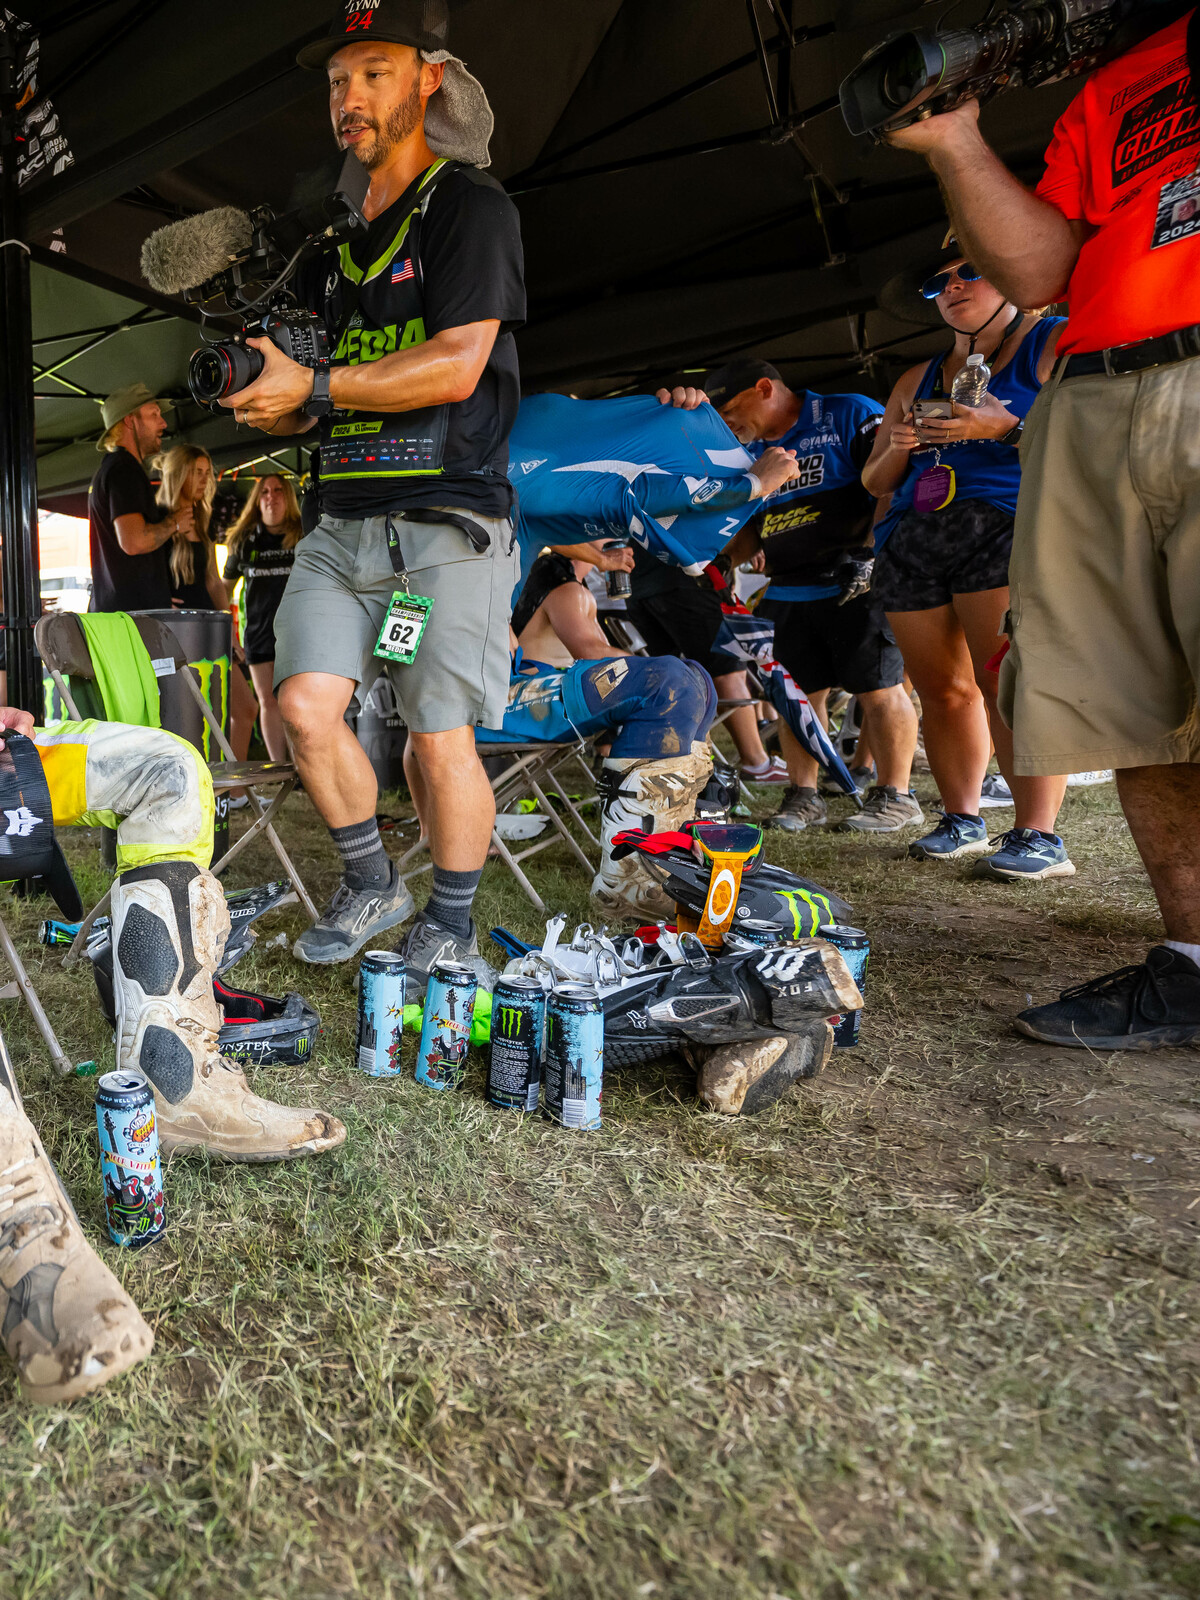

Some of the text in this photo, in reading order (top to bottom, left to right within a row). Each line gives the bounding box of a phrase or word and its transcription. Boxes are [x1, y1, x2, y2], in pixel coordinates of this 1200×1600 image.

[810, 433, 841, 447] YAMAH
[761, 512, 821, 539] RIVER
[389, 623, 414, 644] 62
[385, 645, 406, 655] MEDIA
[778, 982, 814, 998] FOX
[559, 1002, 581, 1010] WATER
[508, 1043, 530, 1051] WATER
[100, 1094, 113, 1102] DEEP
[132, 1092, 149, 1102] WATER
